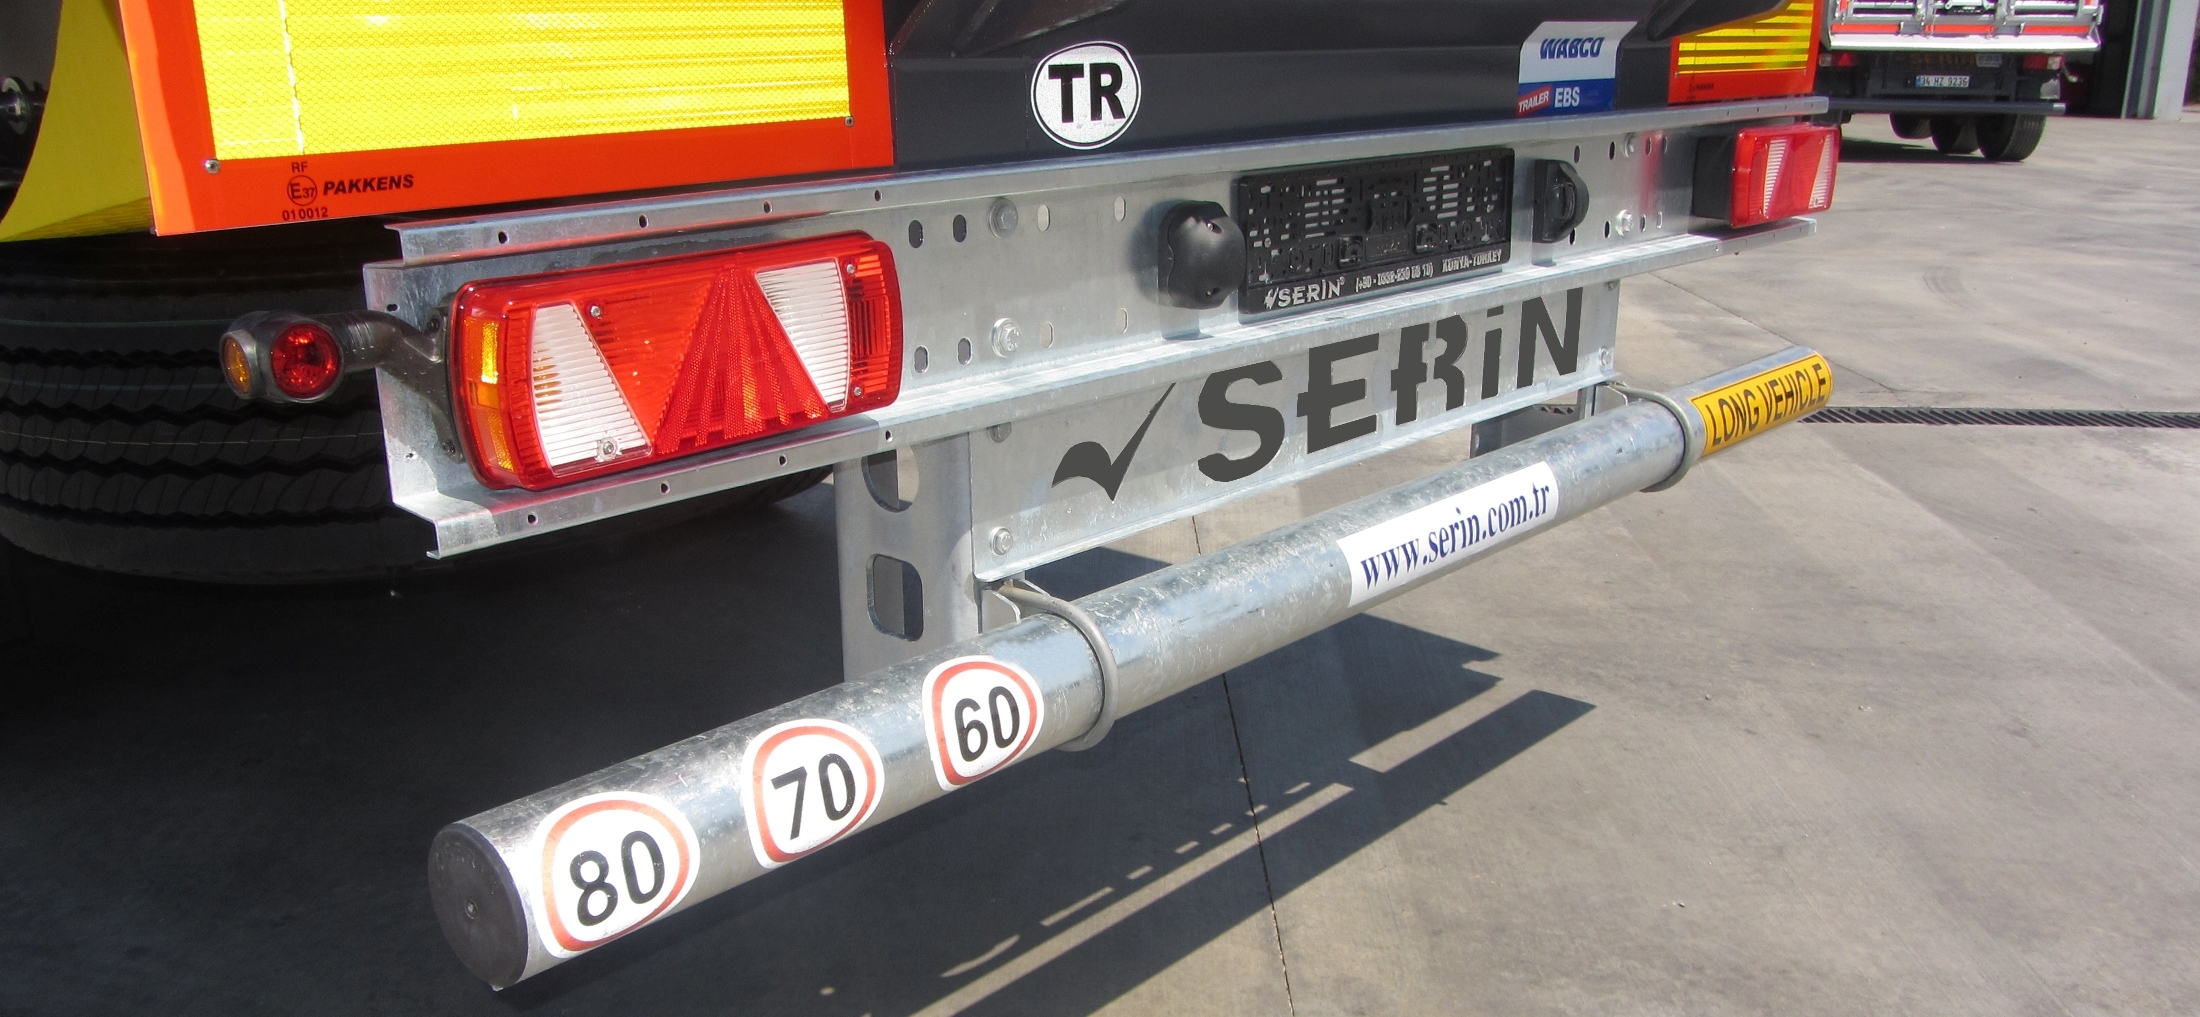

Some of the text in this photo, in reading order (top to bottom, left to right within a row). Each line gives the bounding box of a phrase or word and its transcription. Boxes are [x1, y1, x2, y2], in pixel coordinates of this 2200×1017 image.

[1540, 36, 1605, 60] WABCO
[1047, 63, 1126, 124] TR
[1518, 86, 1580, 114] TRAILER EBS
[1921, 76, 1968, 87] 34 HZ 9236
[291, 161, 308, 173] RF
[322, 174, 415, 196] PAKKENS
[1442, 248, 1502, 273] KONYA-TURKEY
[1705, 363, 1827, 447] LONG VEHICLE
[1360, 481, 1550, 591] www.serin.com.tr
[954, 684, 1021, 763] 60
[770, 752, 856, 841] 70
[568, 830, 666, 927] 80
